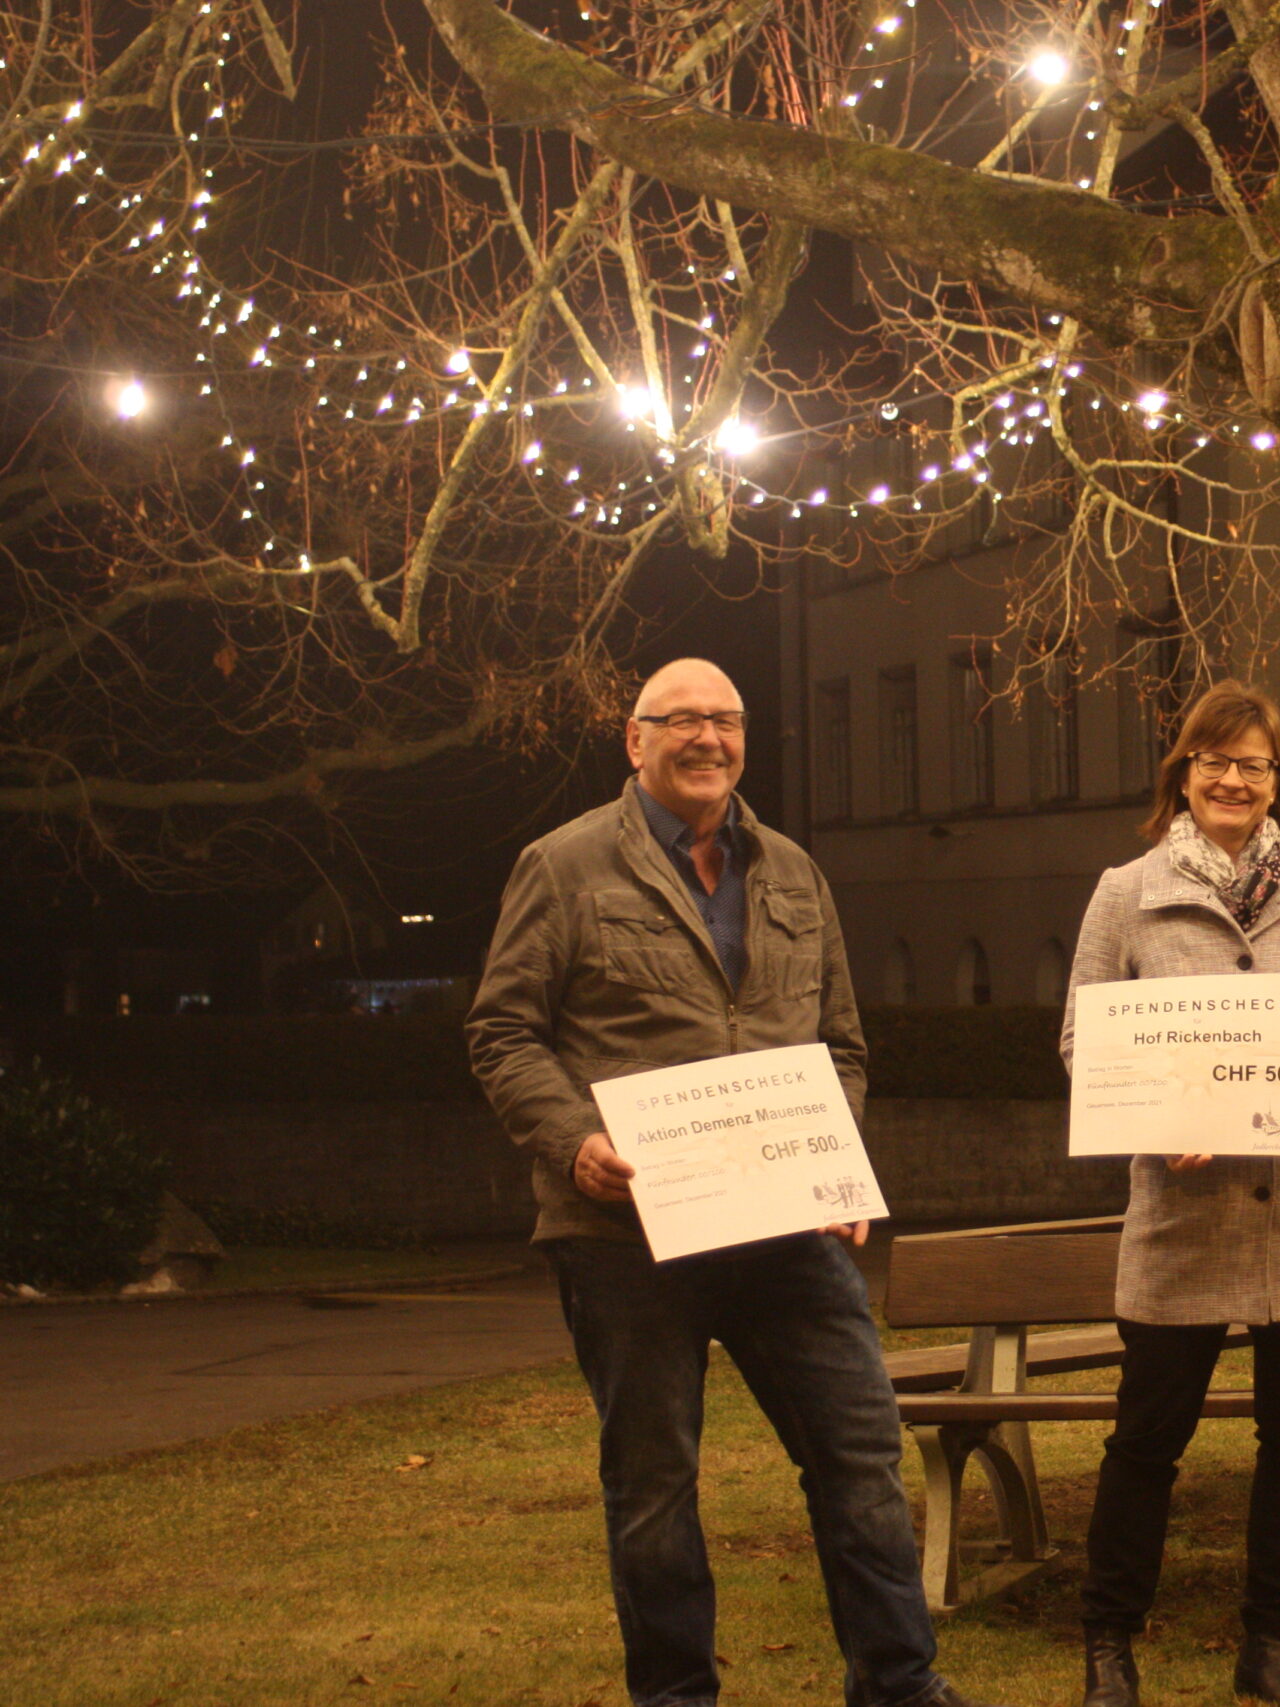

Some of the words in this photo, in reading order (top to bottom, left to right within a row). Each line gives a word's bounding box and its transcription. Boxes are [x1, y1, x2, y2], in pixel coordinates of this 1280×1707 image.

[1134, 1031, 1162, 1045] Hof
[1166, 1029, 1262, 1044] Rickenbach
[1212, 1064, 1258, 1082] CHF
[636, 1070, 807, 1111] SPENDENSCHECK
[637, 1126, 688, 1146] Aktion
[690, 1114, 754, 1135] Demenz
[756, 1101, 828, 1122] Mauensee
[761, 1139, 802, 1162] CHF
[807, 1134, 852, 1155] 500.-
